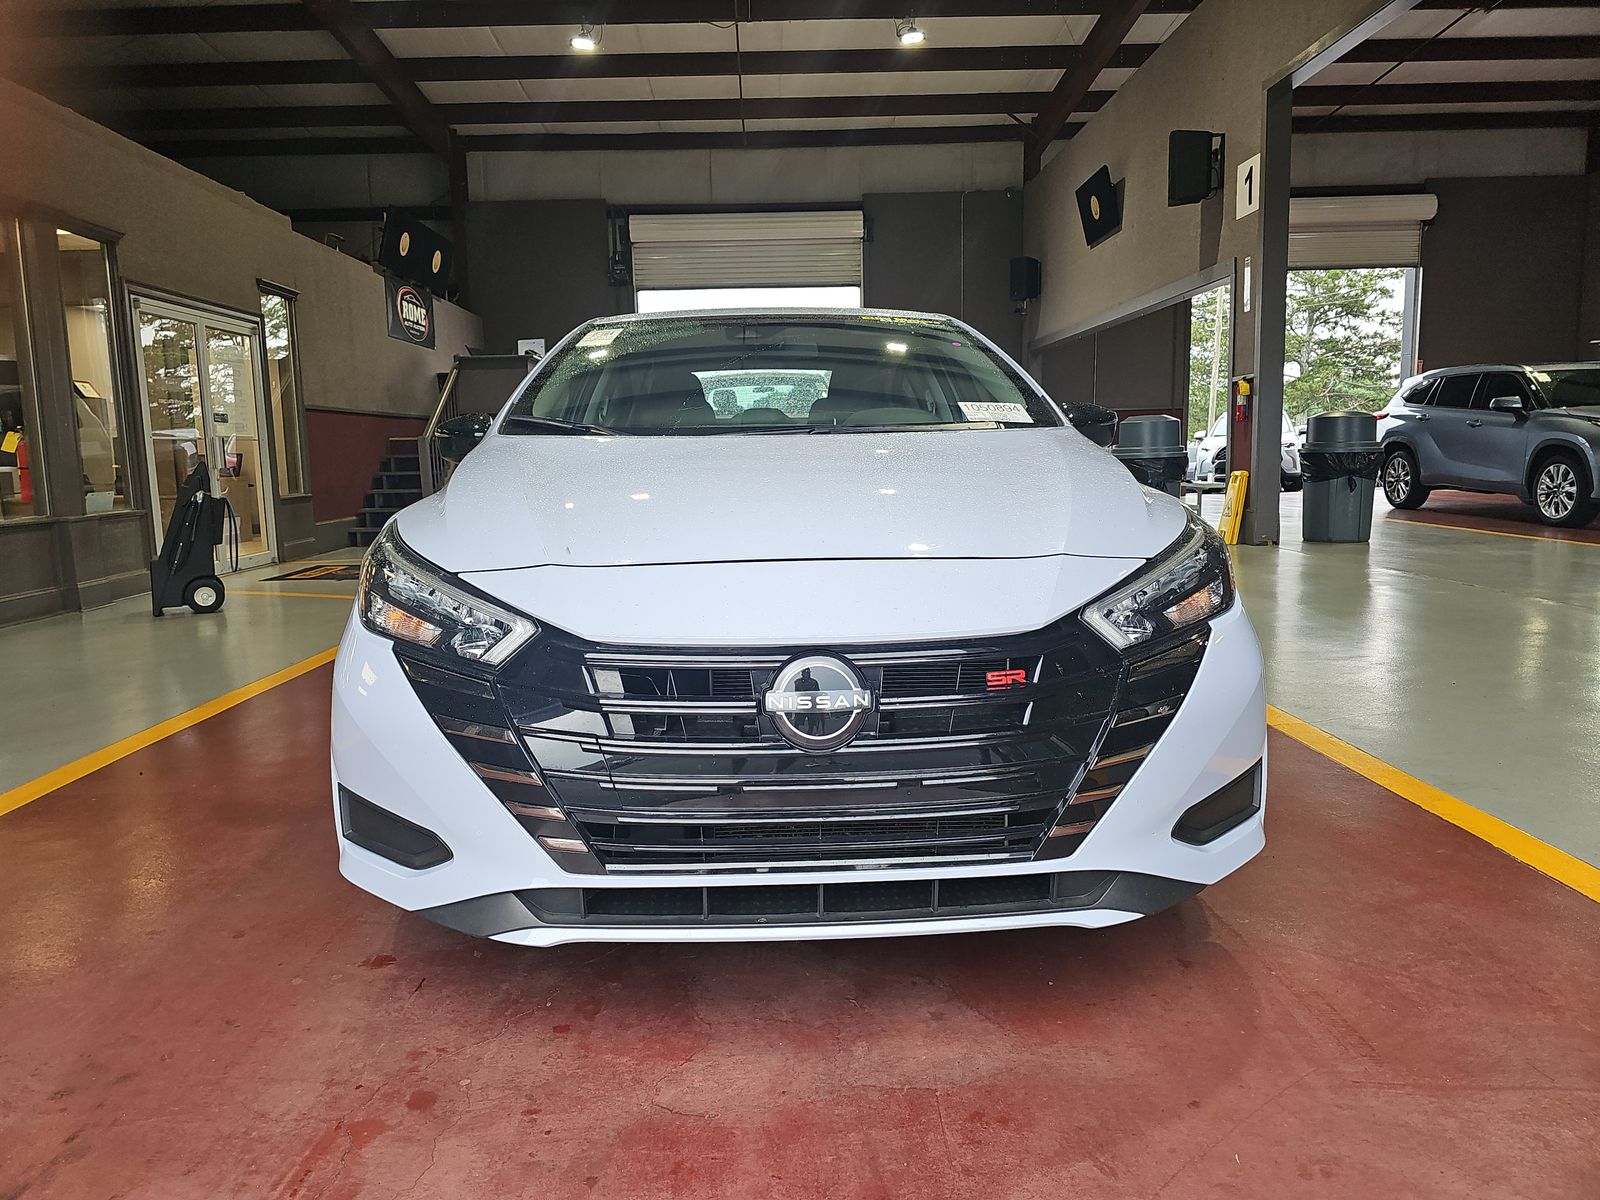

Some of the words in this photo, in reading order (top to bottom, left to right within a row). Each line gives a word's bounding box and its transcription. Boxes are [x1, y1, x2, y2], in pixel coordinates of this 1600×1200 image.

[1244, 165, 1254, 206] 1
[402, 300, 427, 326] ROME
[986, 670, 1027, 686] SR
[768, 693, 869, 710] NISSAN
